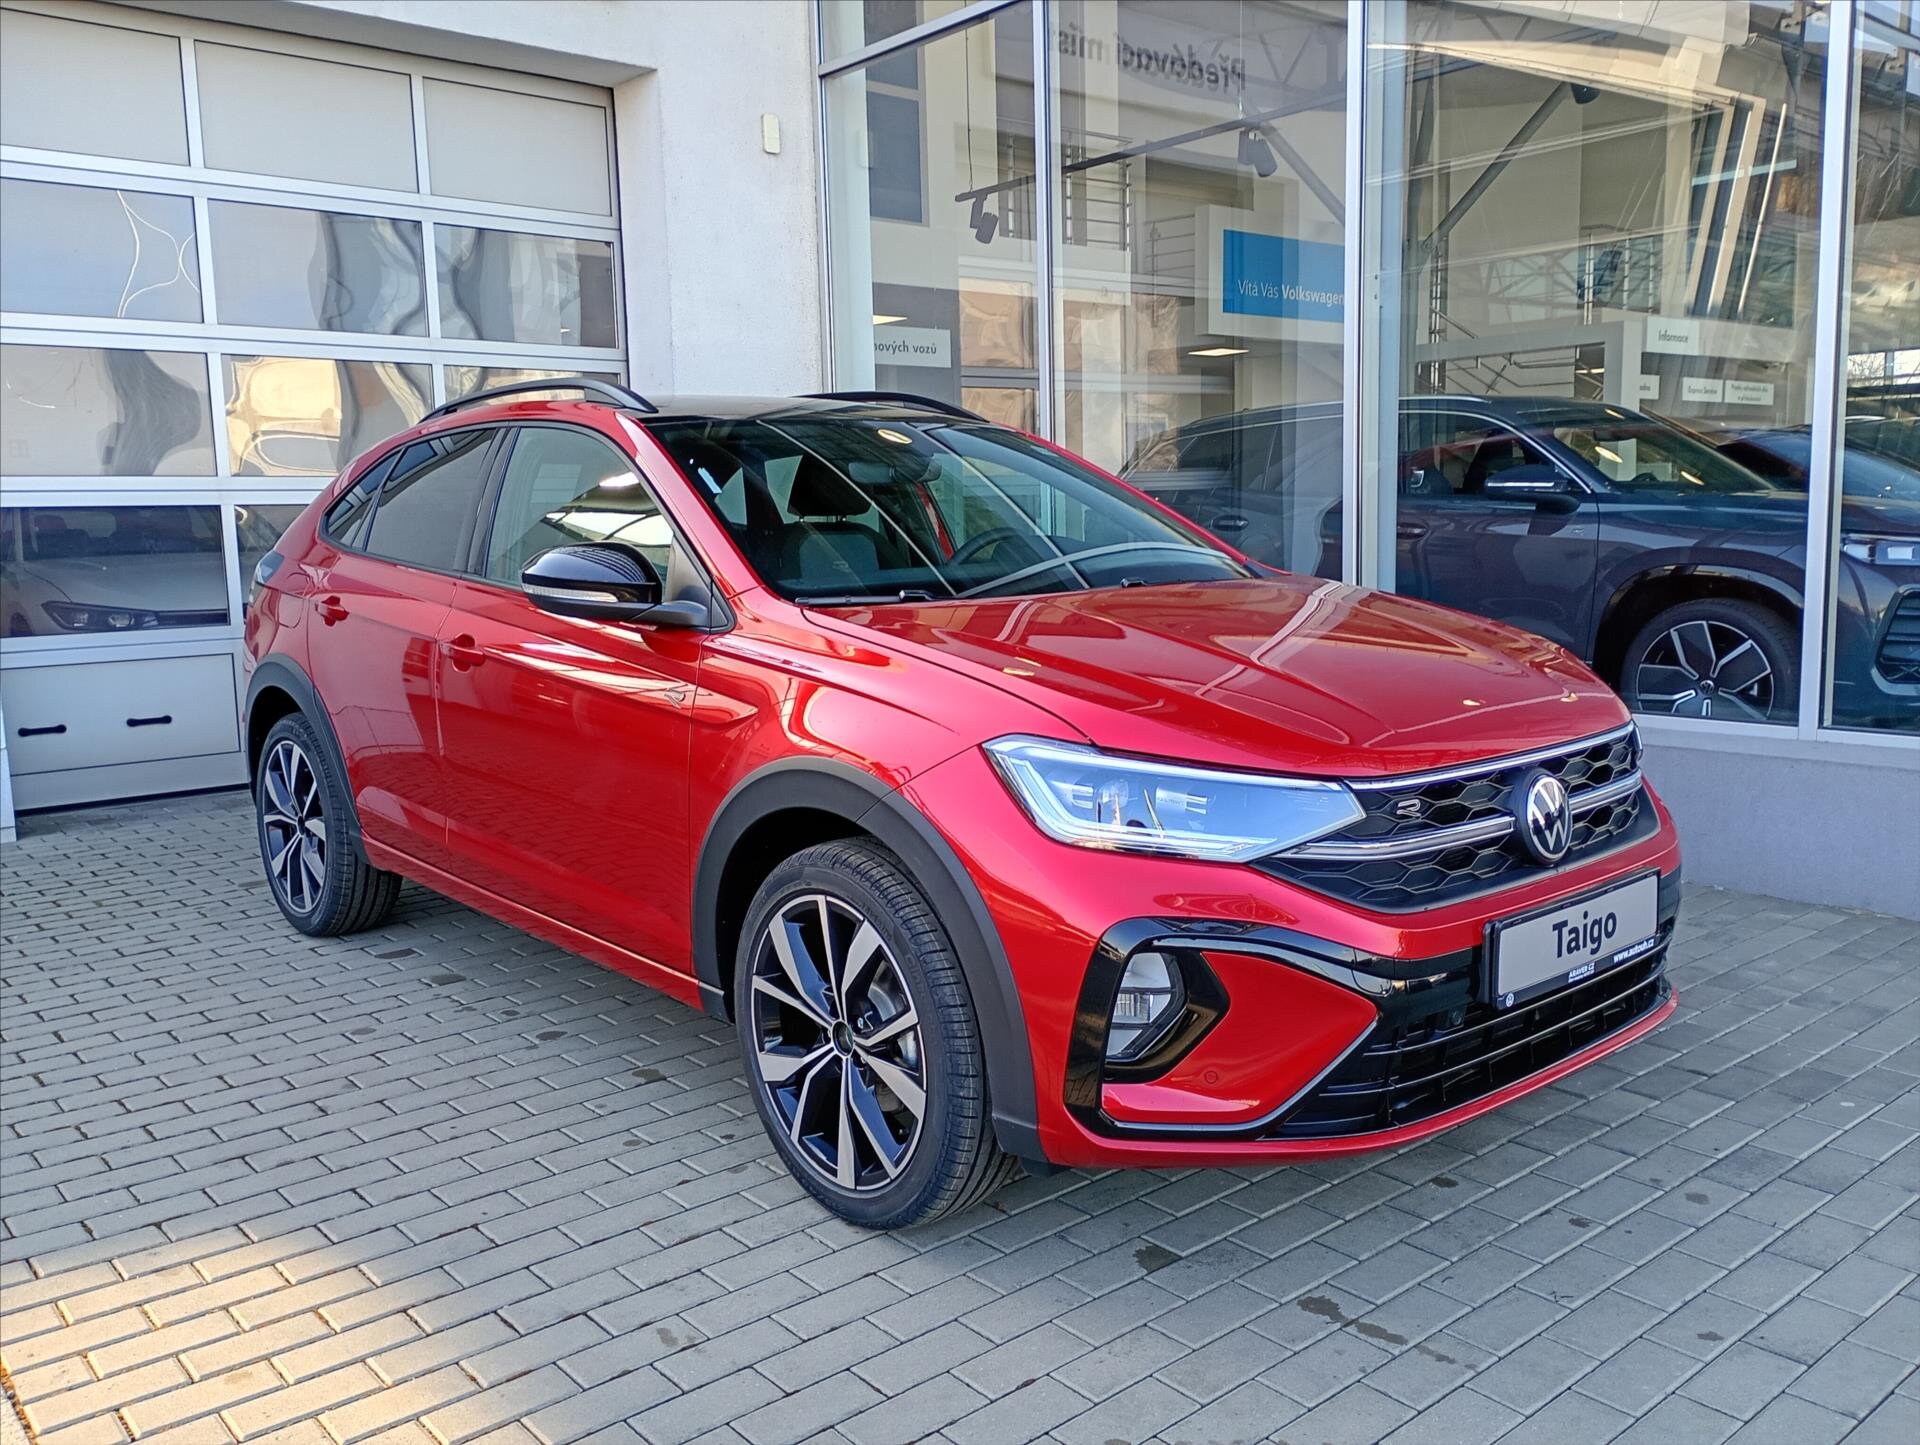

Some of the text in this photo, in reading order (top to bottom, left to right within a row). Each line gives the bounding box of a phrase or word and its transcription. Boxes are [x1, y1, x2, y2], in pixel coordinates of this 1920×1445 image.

[1238, 279, 1258, 297] Vítá
[1260, 281, 1279, 298] Vás
[1658, 329, 1689, 343] Informace
[912, 342, 937, 354] vozů
[1552, 910, 1617, 958] Taigo
